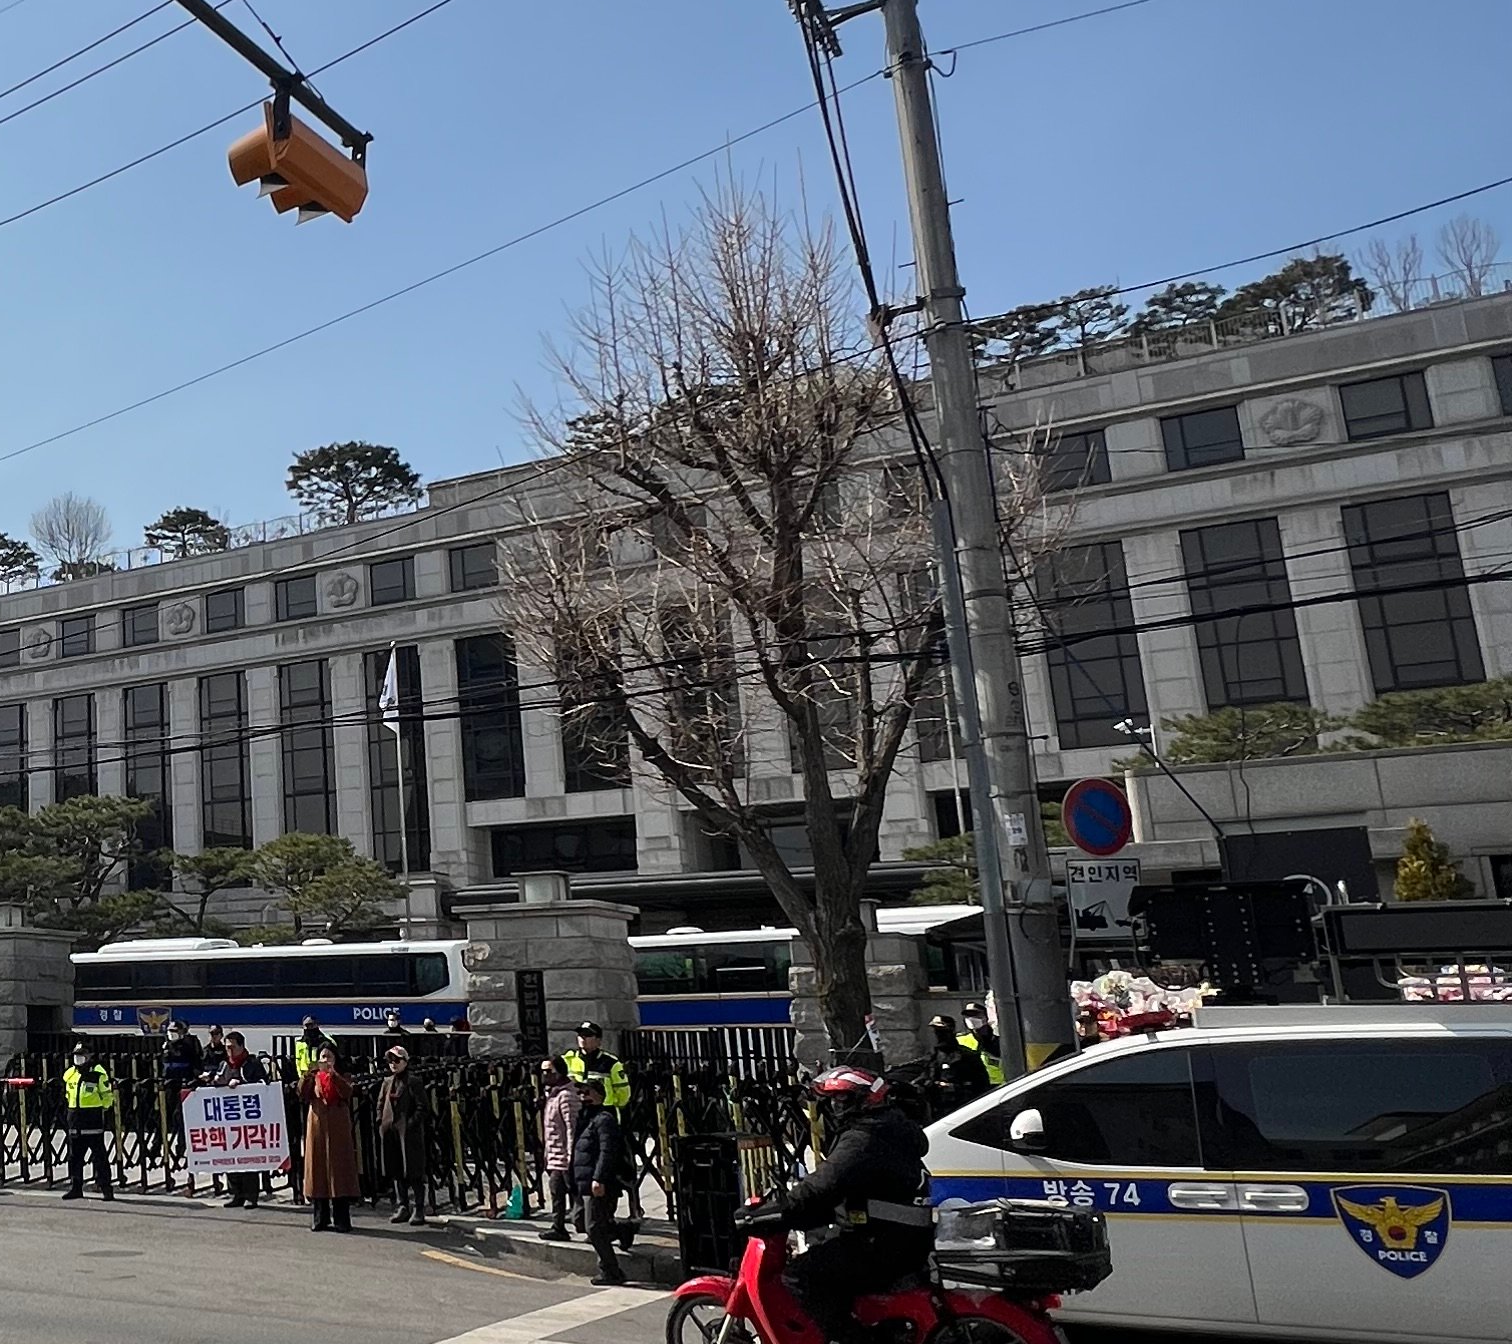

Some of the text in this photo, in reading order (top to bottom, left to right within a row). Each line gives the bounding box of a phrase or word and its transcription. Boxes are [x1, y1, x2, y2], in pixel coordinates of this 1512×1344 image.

[1068, 864, 1138, 883] 견인지역
[203, 1094, 262, 1122] 대통령
[189, 1123, 280, 1153] 탄핵 기각!!
[1042, 1180, 1141, 1206] 방송 74
[1359, 1229, 1438, 1244] 경 찰
[1378, 1250, 1428, 1262] POLICE
